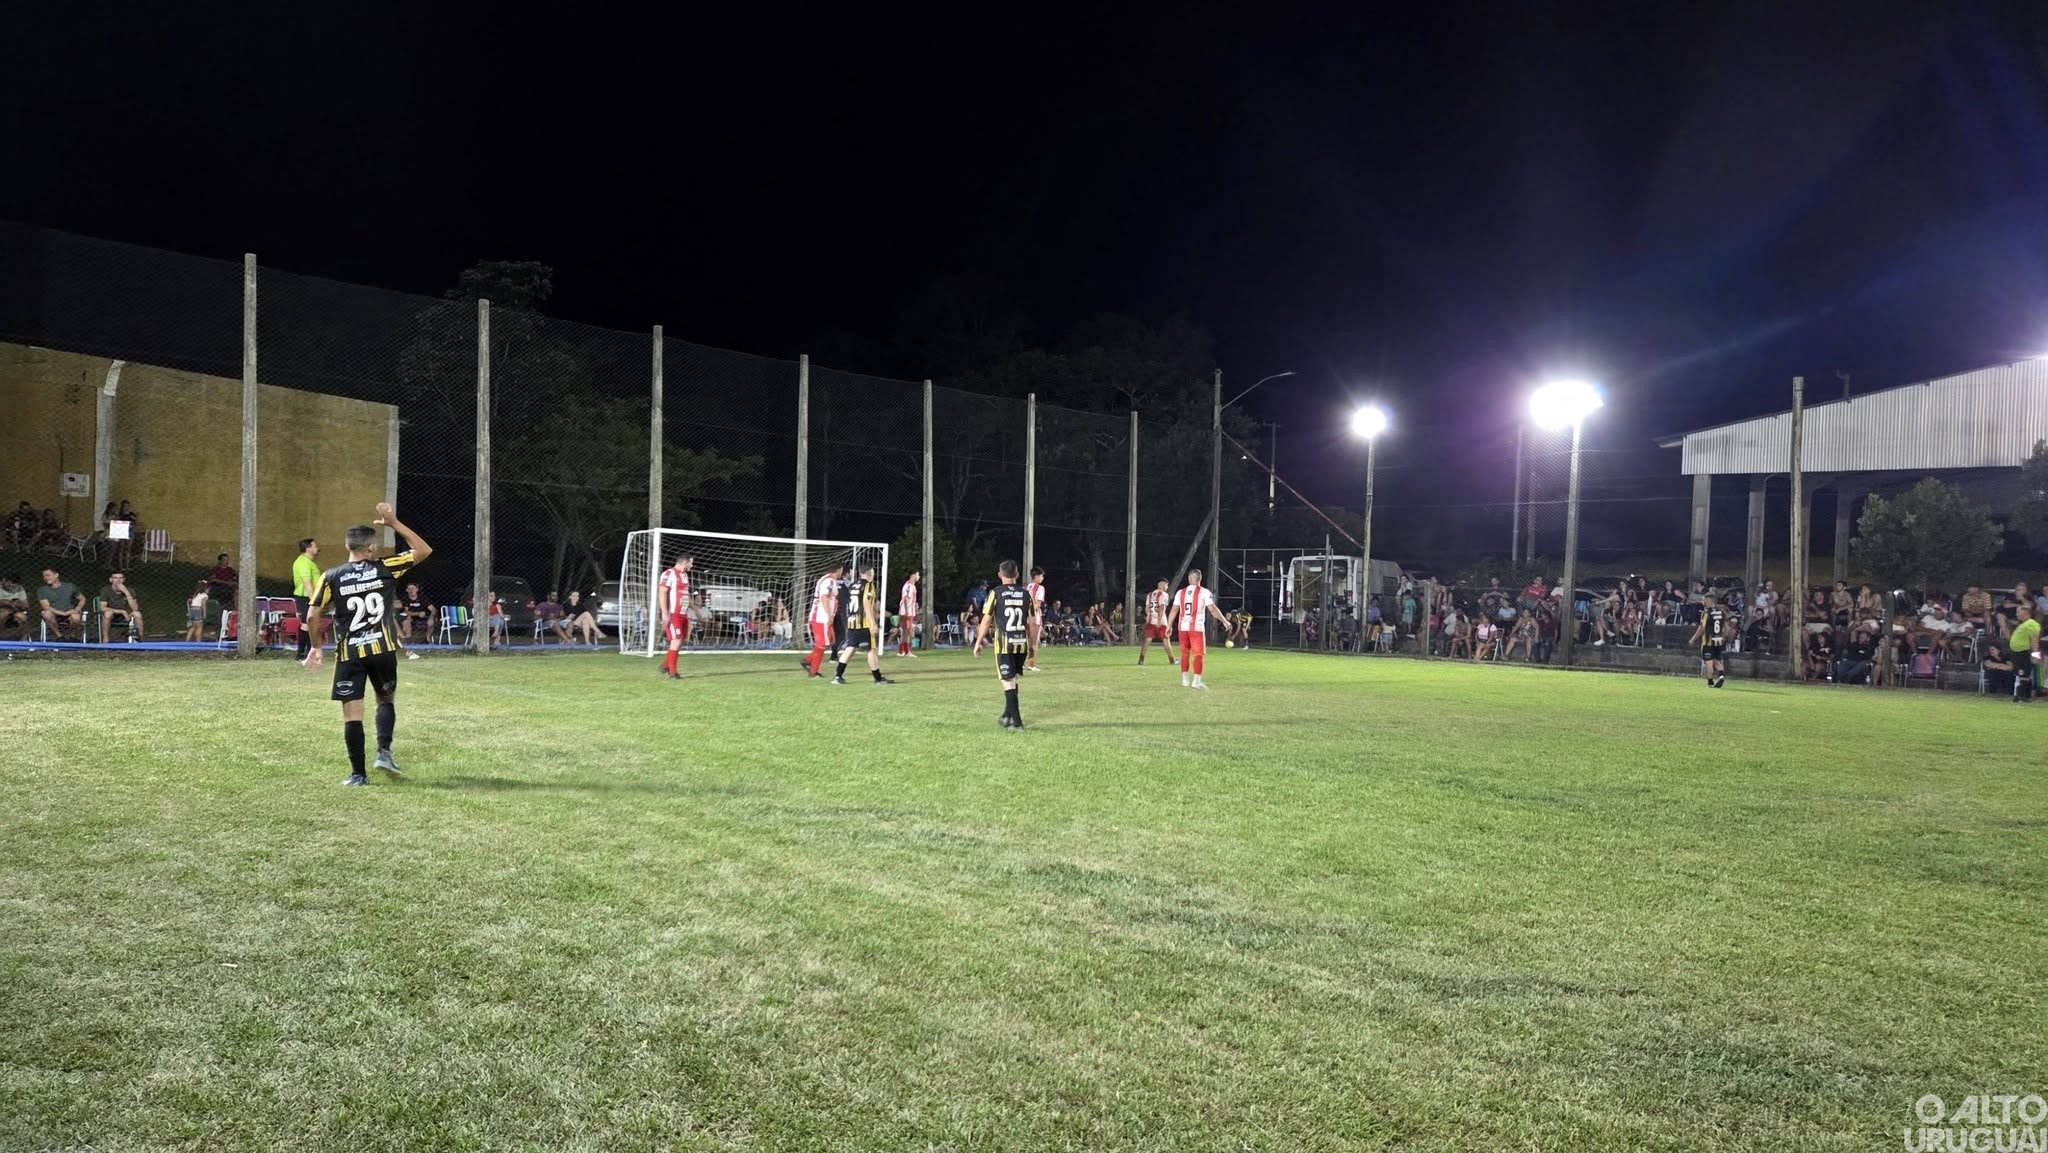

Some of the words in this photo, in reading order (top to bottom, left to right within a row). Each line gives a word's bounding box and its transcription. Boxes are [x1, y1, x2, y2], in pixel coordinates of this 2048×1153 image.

[339, 578, 385, 596] GUILHERME
[346, 592, 385, 632] 29
[1004, 607, 1026, 632] 22
[1713, 619, 1721, 634] 6
